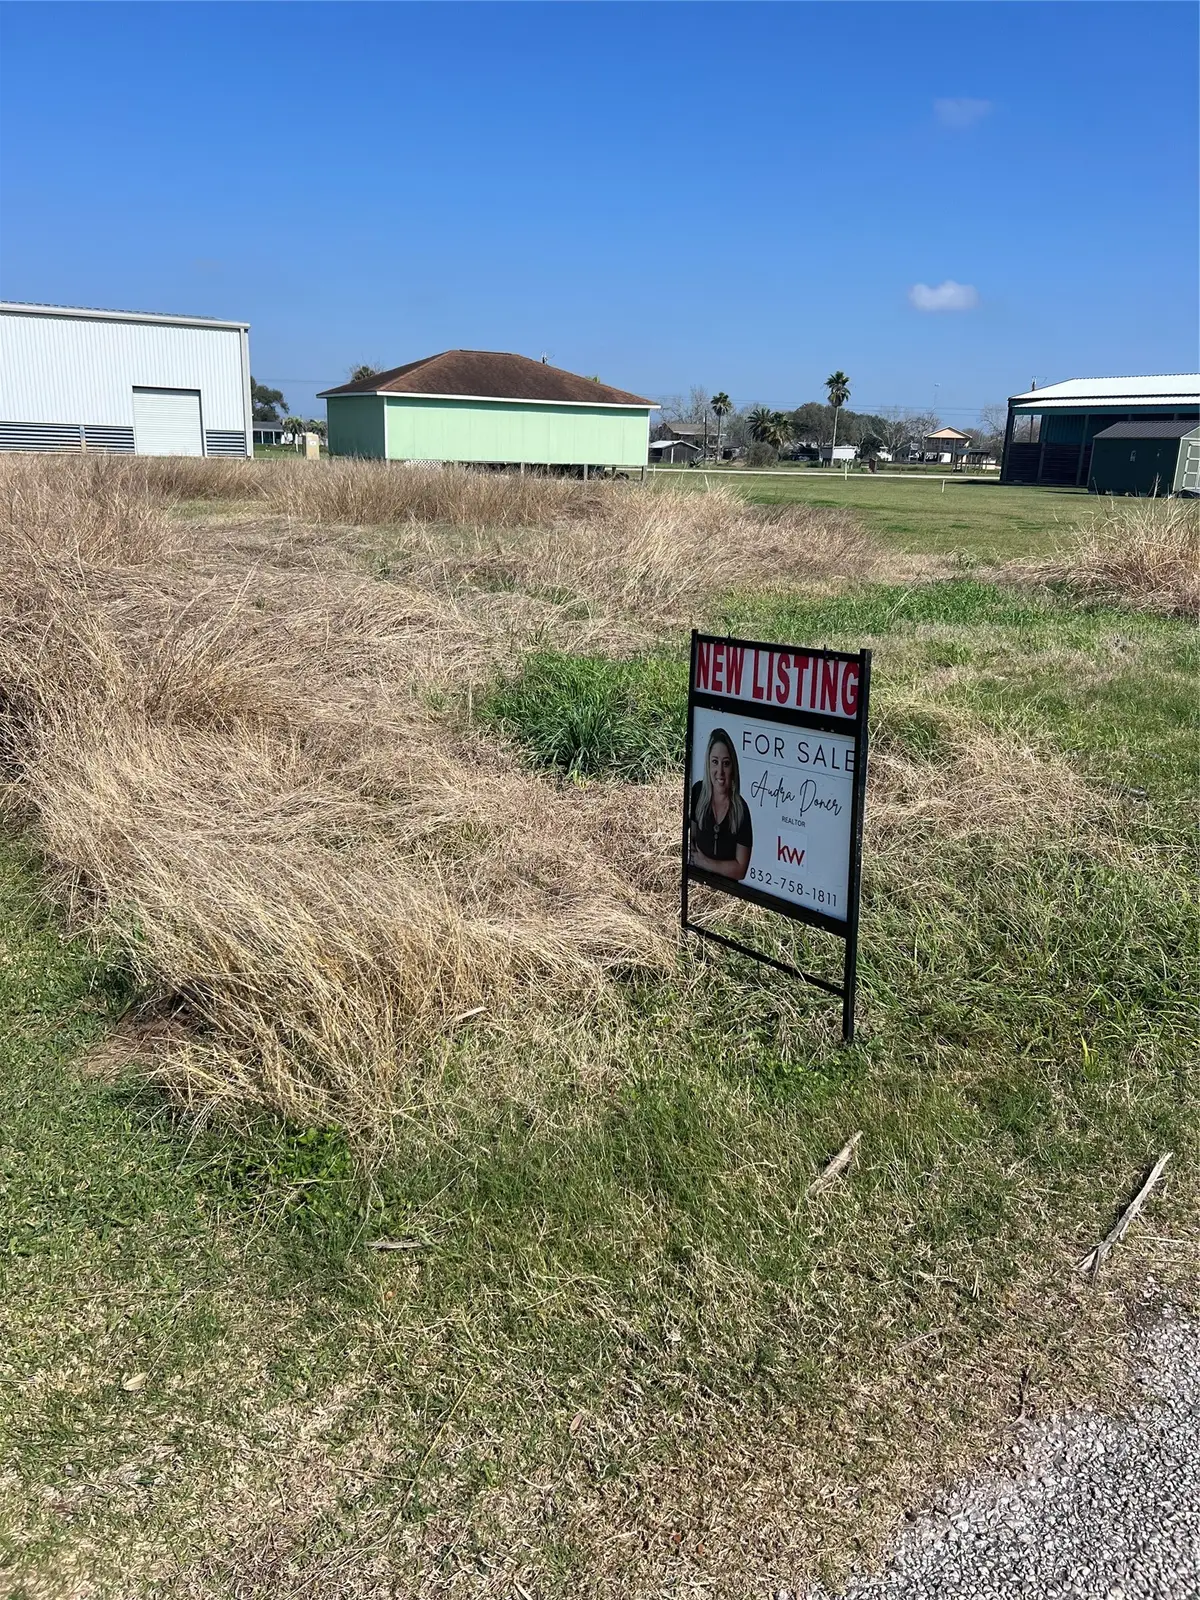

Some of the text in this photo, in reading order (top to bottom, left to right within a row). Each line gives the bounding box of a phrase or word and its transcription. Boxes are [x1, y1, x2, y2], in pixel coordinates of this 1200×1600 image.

[696, 642, 860, 716] NEW LISTING
[742, 731, 855, 773] FOR SALE
[750, 770, 795, 808] Audra
[781, 815, 806, 828] REALTOR
[777, 835, 805, 867] kw
[749, 868, 837, 908] 832-758-1811
